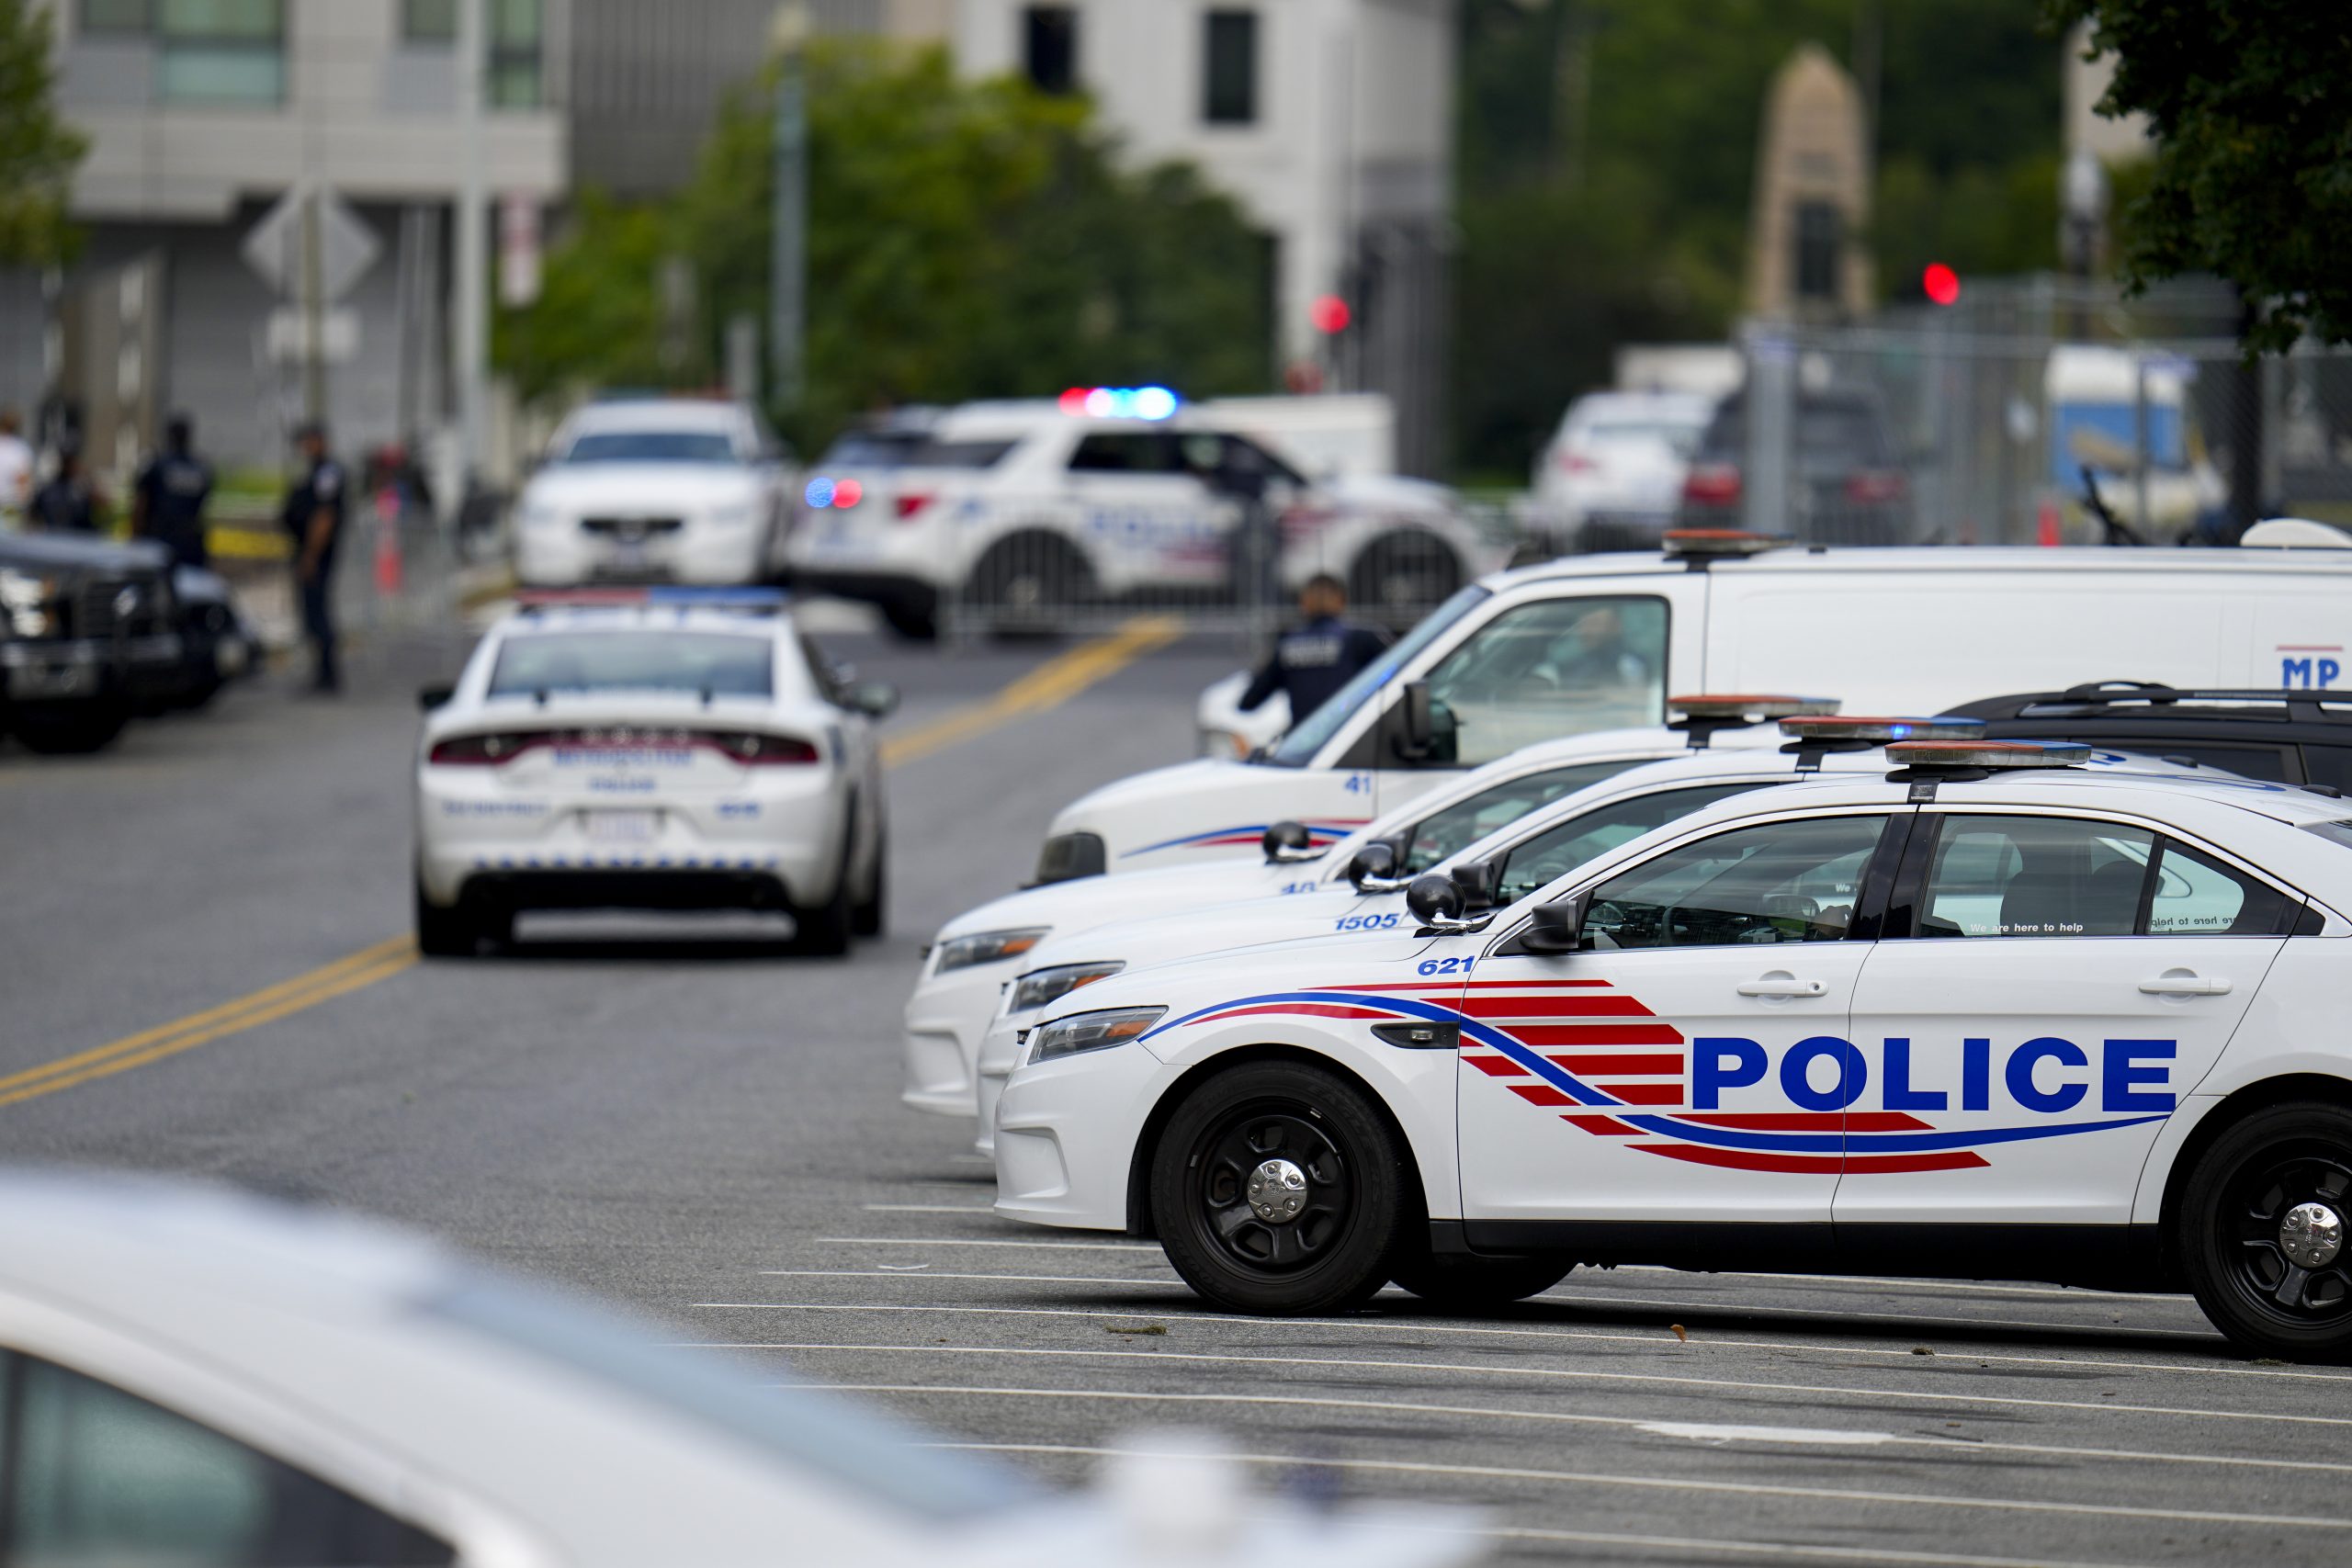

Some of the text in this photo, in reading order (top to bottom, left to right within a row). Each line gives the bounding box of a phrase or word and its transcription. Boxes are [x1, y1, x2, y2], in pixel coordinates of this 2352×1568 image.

[2282, 659, 2340, 690] MP
[1344, 774, 1372, 795] 41
[1335, 913, 1400, 931] 1505
[1970, 923, 1986, 931] We
[2014, 923, 2039, 931] here
[2044, 923, 2055, 931] to
[2060, 922, 2083, 933] help
[1418, 955, 1476, 976] 621
[1692, 1036, 2177, 1113] POLICE
